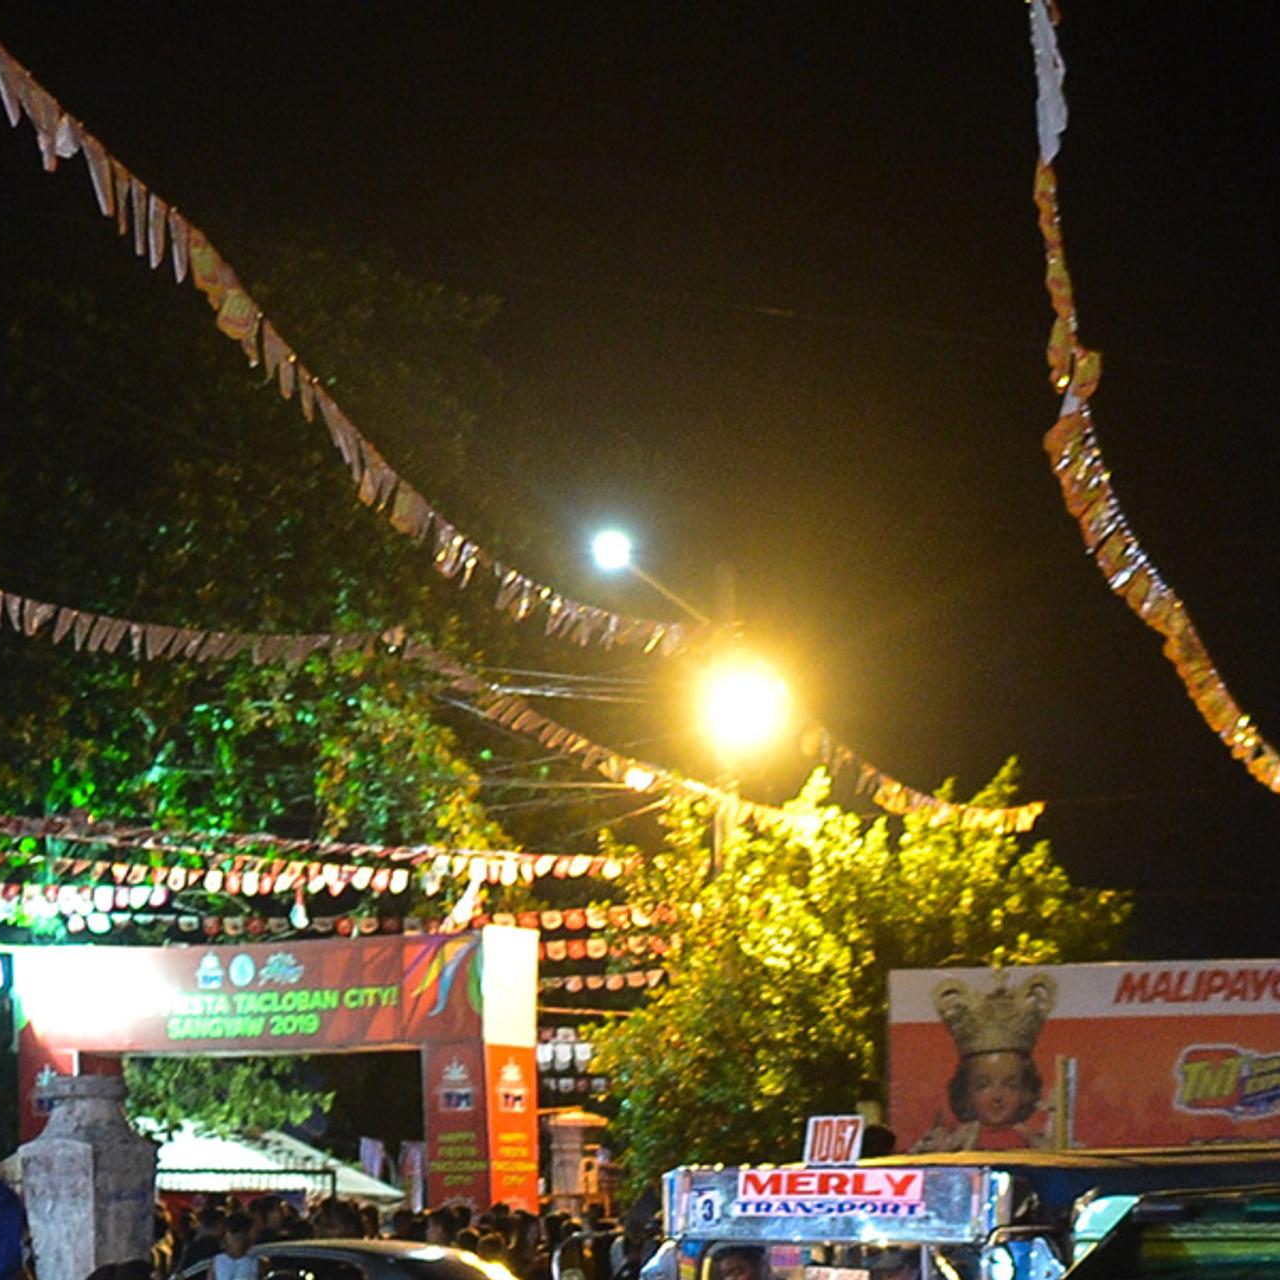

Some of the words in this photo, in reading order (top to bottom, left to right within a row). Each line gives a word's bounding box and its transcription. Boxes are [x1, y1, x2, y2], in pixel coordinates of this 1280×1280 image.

[235, 987, 340, 1014] TACLOBAN
[343, 985, 400, 1009] CITY!
[269, 1012, 320, 1035] 2019
[810, 1118, 860, 1163] 1067
[741, 1170, 920, 1197] MERLY
[701, 1198, 715, 1222] 3
[737, 1201, 922, 1216] TRANSPORT
